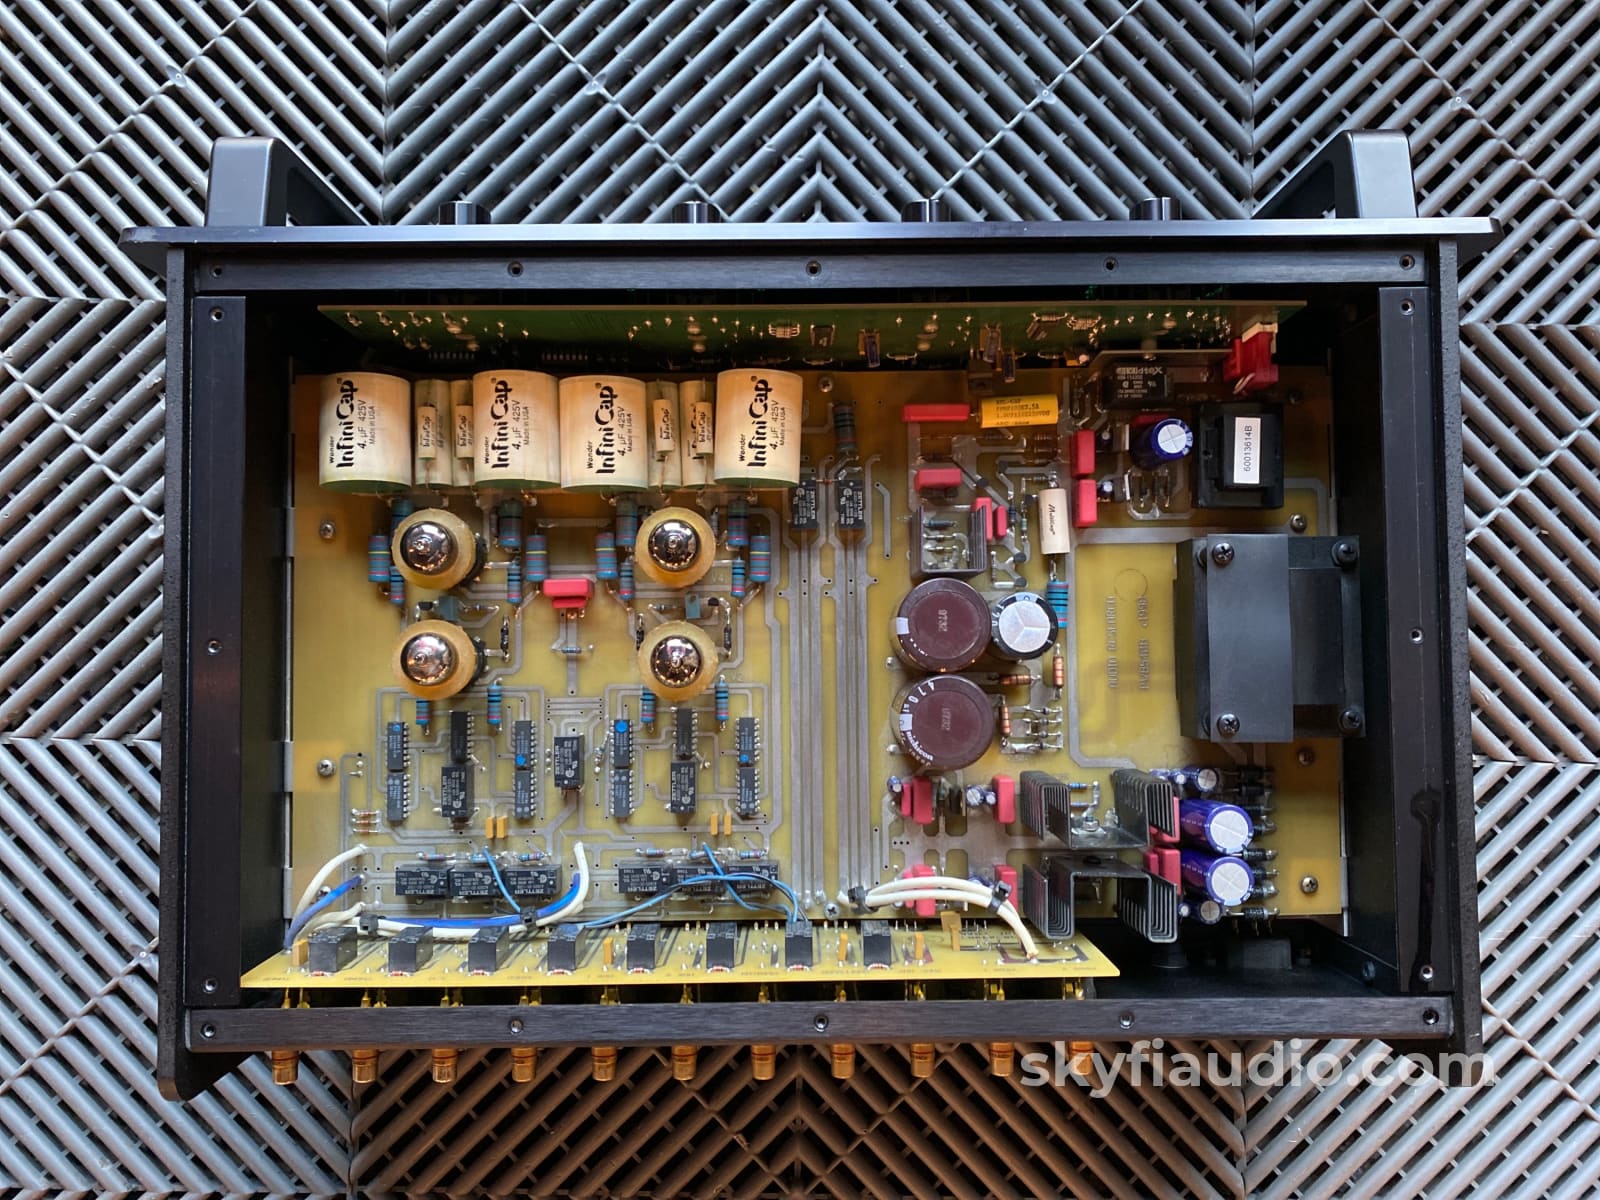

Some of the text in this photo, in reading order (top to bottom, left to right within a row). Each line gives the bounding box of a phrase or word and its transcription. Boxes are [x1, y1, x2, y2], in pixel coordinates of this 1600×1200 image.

[357, 400, 367, 422] 425V
[511, 400, 521, 422] 425V
[617, 406, 626, 428] 425V
[771, 400, 780, 422] 425V
[1243, 425, 1253, 472] 60013614B
